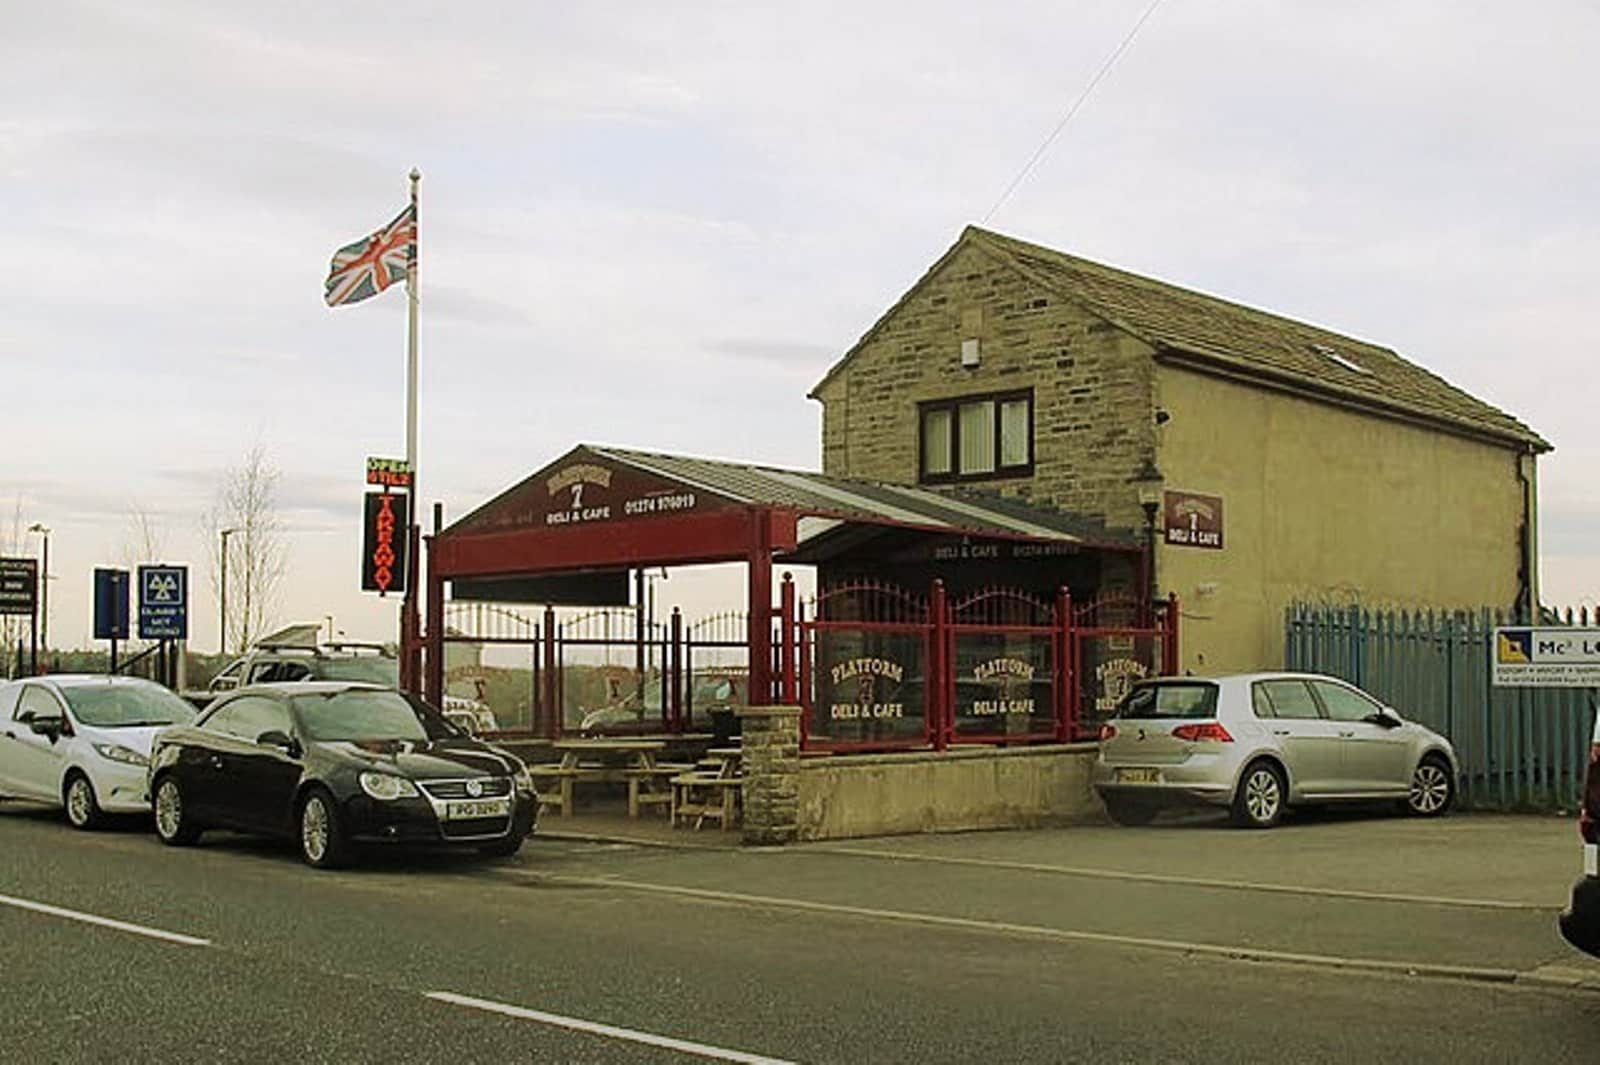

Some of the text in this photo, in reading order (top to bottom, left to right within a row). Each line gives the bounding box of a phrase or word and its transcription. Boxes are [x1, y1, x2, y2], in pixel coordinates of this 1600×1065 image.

[571, 484, 583, 509] 7
[546, 511, 570, 525] DELI
[571, 510, 580, 522] &
[582, 506, 610, 520] CAFE
[1169, 528, 1188, 543] DELI
[1199, 531, 1219, 546] CAFE
[831, 658, 903, 685] PLATFORM
[974, 658, 1036, 682] PLATFORM
[1095, 659, 1148, 680] PLATFORM
[831, 703, 903, 719] DELI & CAFE
[973, 699, 1036, 716] DELI & CAFE
